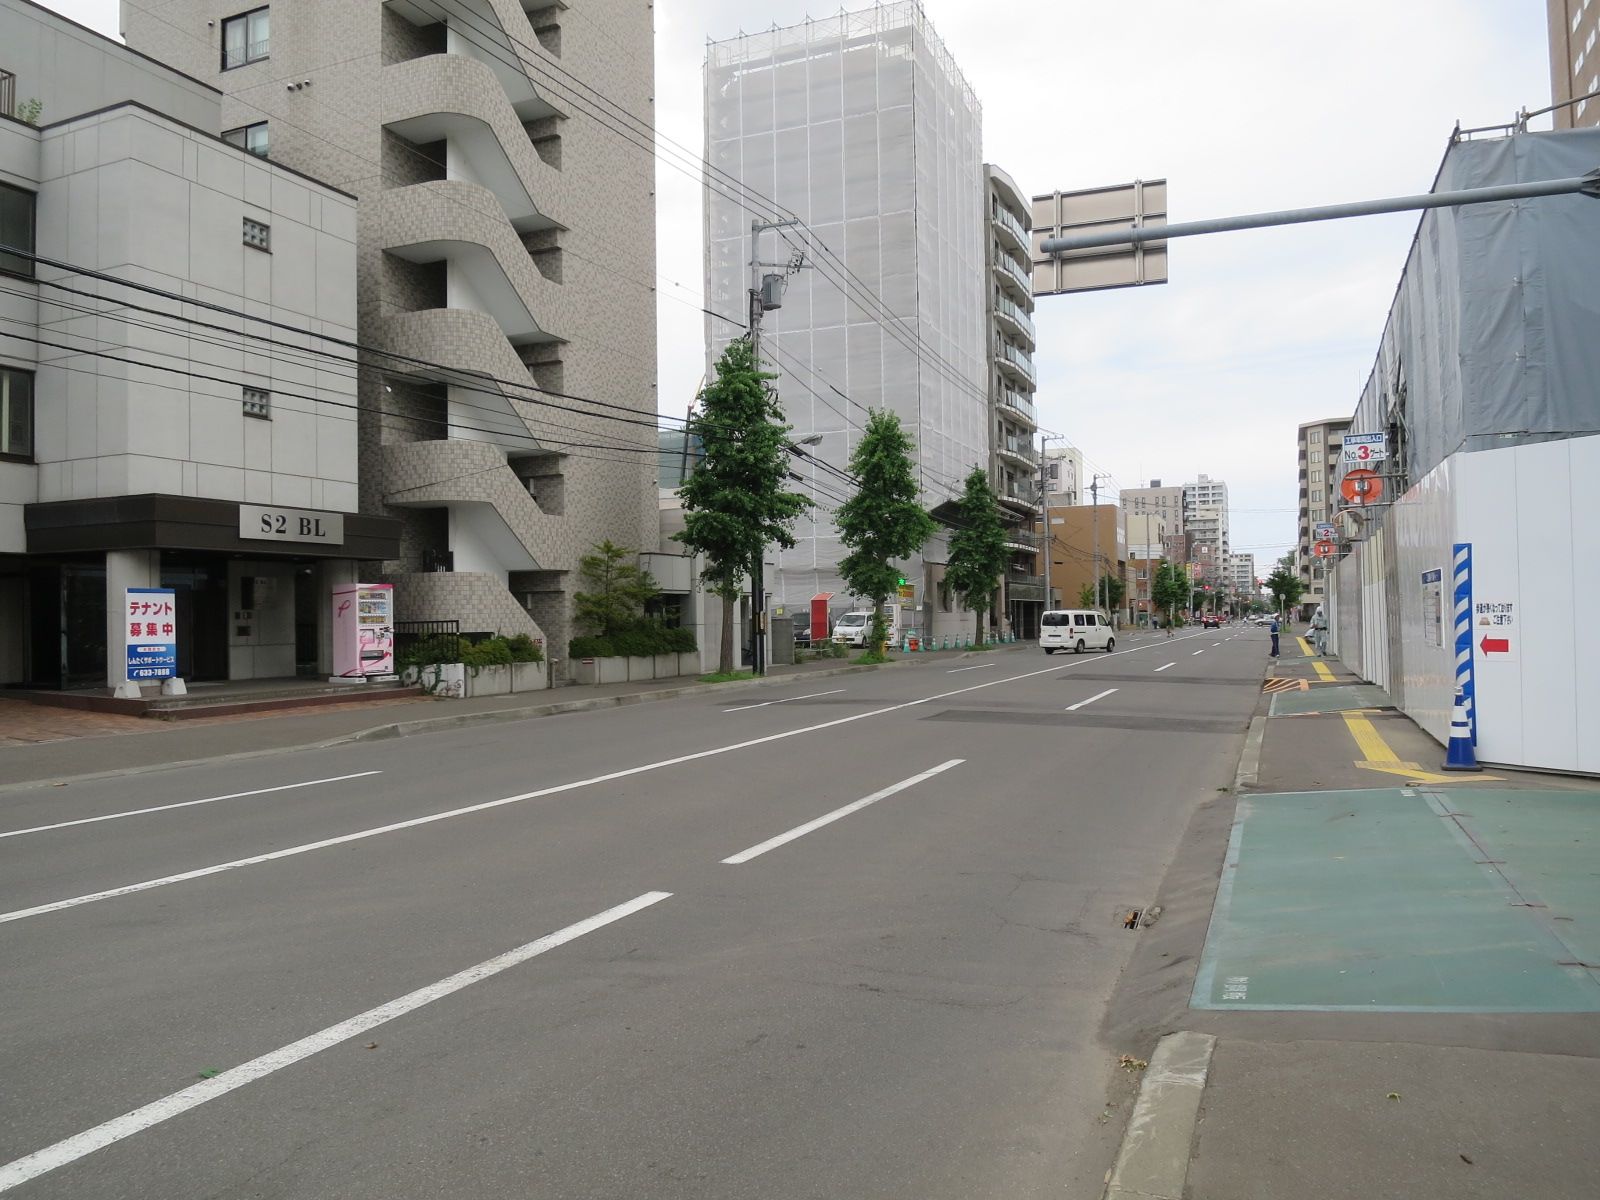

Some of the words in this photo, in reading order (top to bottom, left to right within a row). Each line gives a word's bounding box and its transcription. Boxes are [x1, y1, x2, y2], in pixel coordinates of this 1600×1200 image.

[260, 513, 287, 534] S2
[298, 517, 326, 537] BL
[129, 601, 173, 615] テナント
[129, 622, 173, 637] 募集中
[128, 656, 175, 665] しんたくサポートサービス
